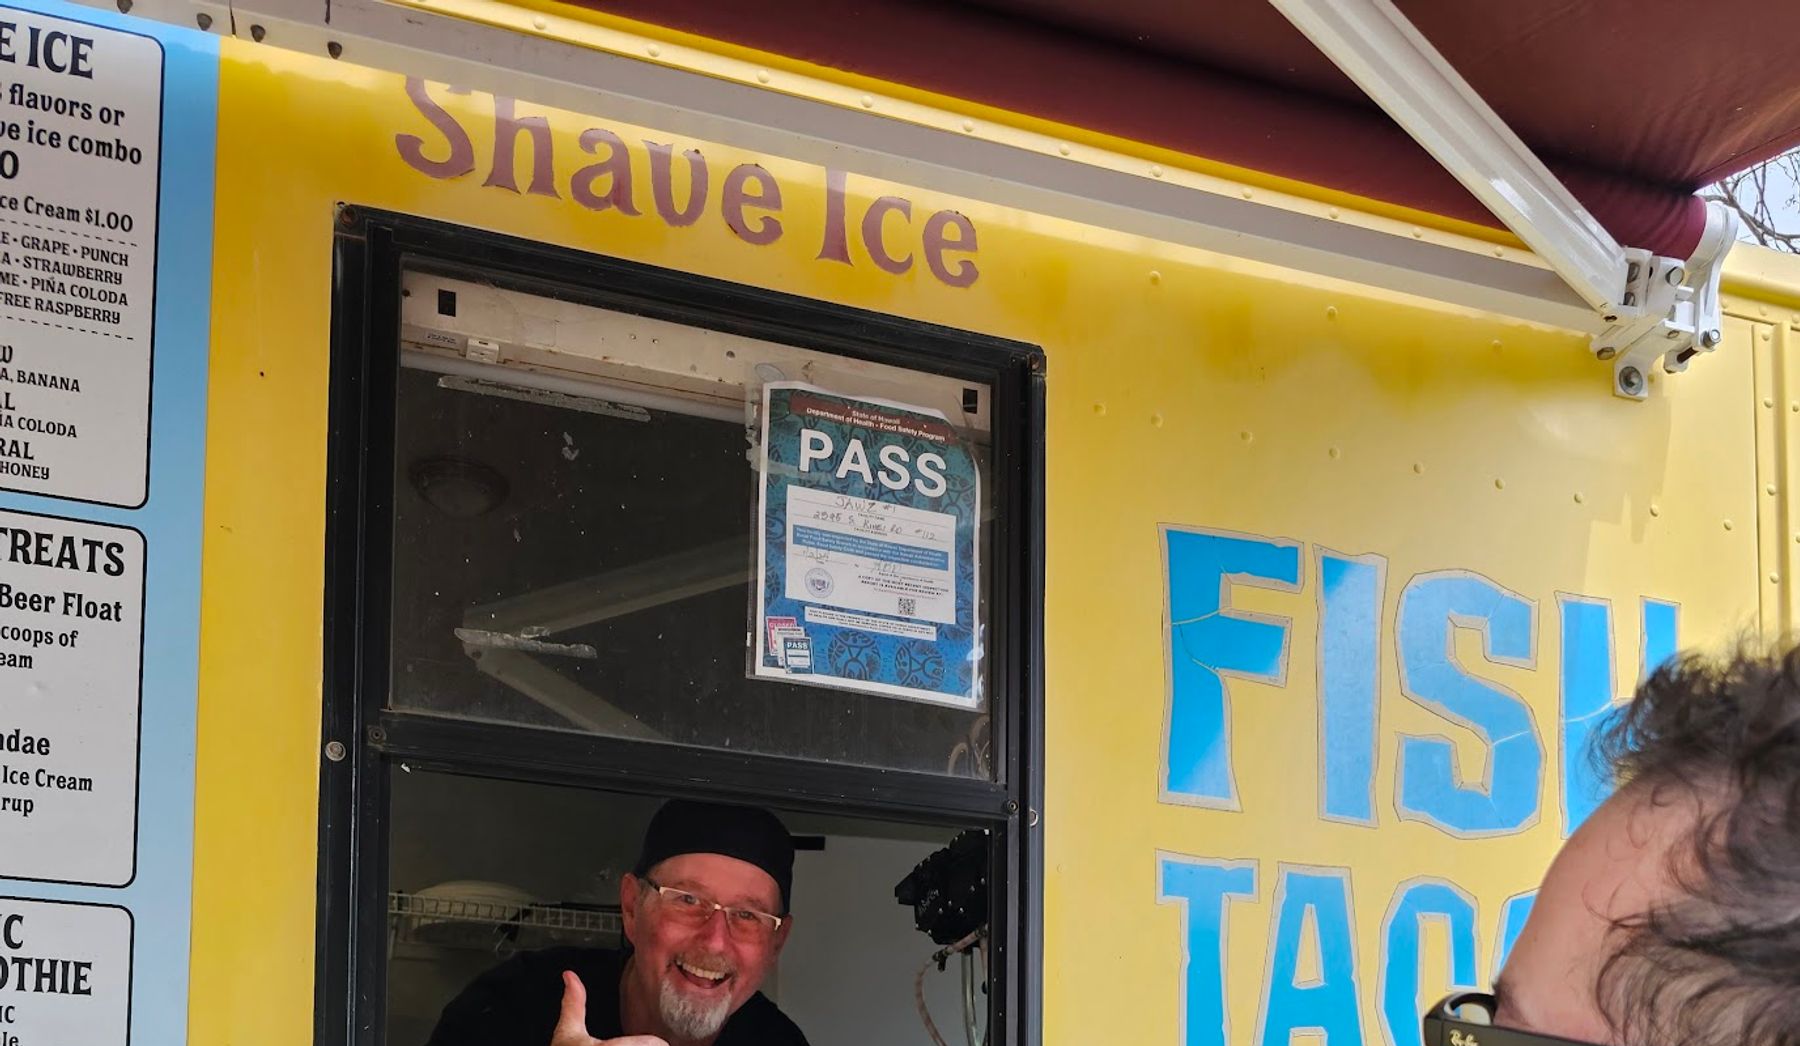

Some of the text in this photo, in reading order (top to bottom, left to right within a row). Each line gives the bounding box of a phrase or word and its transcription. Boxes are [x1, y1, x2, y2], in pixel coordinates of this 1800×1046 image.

[27, 26, 94, 79] ICE
[9, 83, 93, 121] flavors
[99, 106, 125, 126] or
[26, 120, 62, 148] ice
[68, 134, 142, 165] combo
[394, 75, 980, 289] Shave Ice
[24, 196, 80, 223] Cream
[85, 207, 133, 232] $1.00
[21, 235, 70, 256] GRAPE
[80, 246, 129, 267] PUNCH
[22, 256, 123, 285] STRAWBERRY
[70, 284, 129, 307] COLODA
[34, 298, 121, 325] RASPBERRY
[16, 370, 81, 393] BANANA
[18, 417, 77, 438] COLODA
[806, 407, 845, 423] Department
[917, 430, 946, 443] Program
[0, 461, 50, 480] HONEY
[798, 428, 948, 498] PASS
[62, 592, 122, 623] Float
[58, 630, 79, 648] of
[786, 641, 808, 650] PASS
[2, 765, 93, 792] Ice Cream
